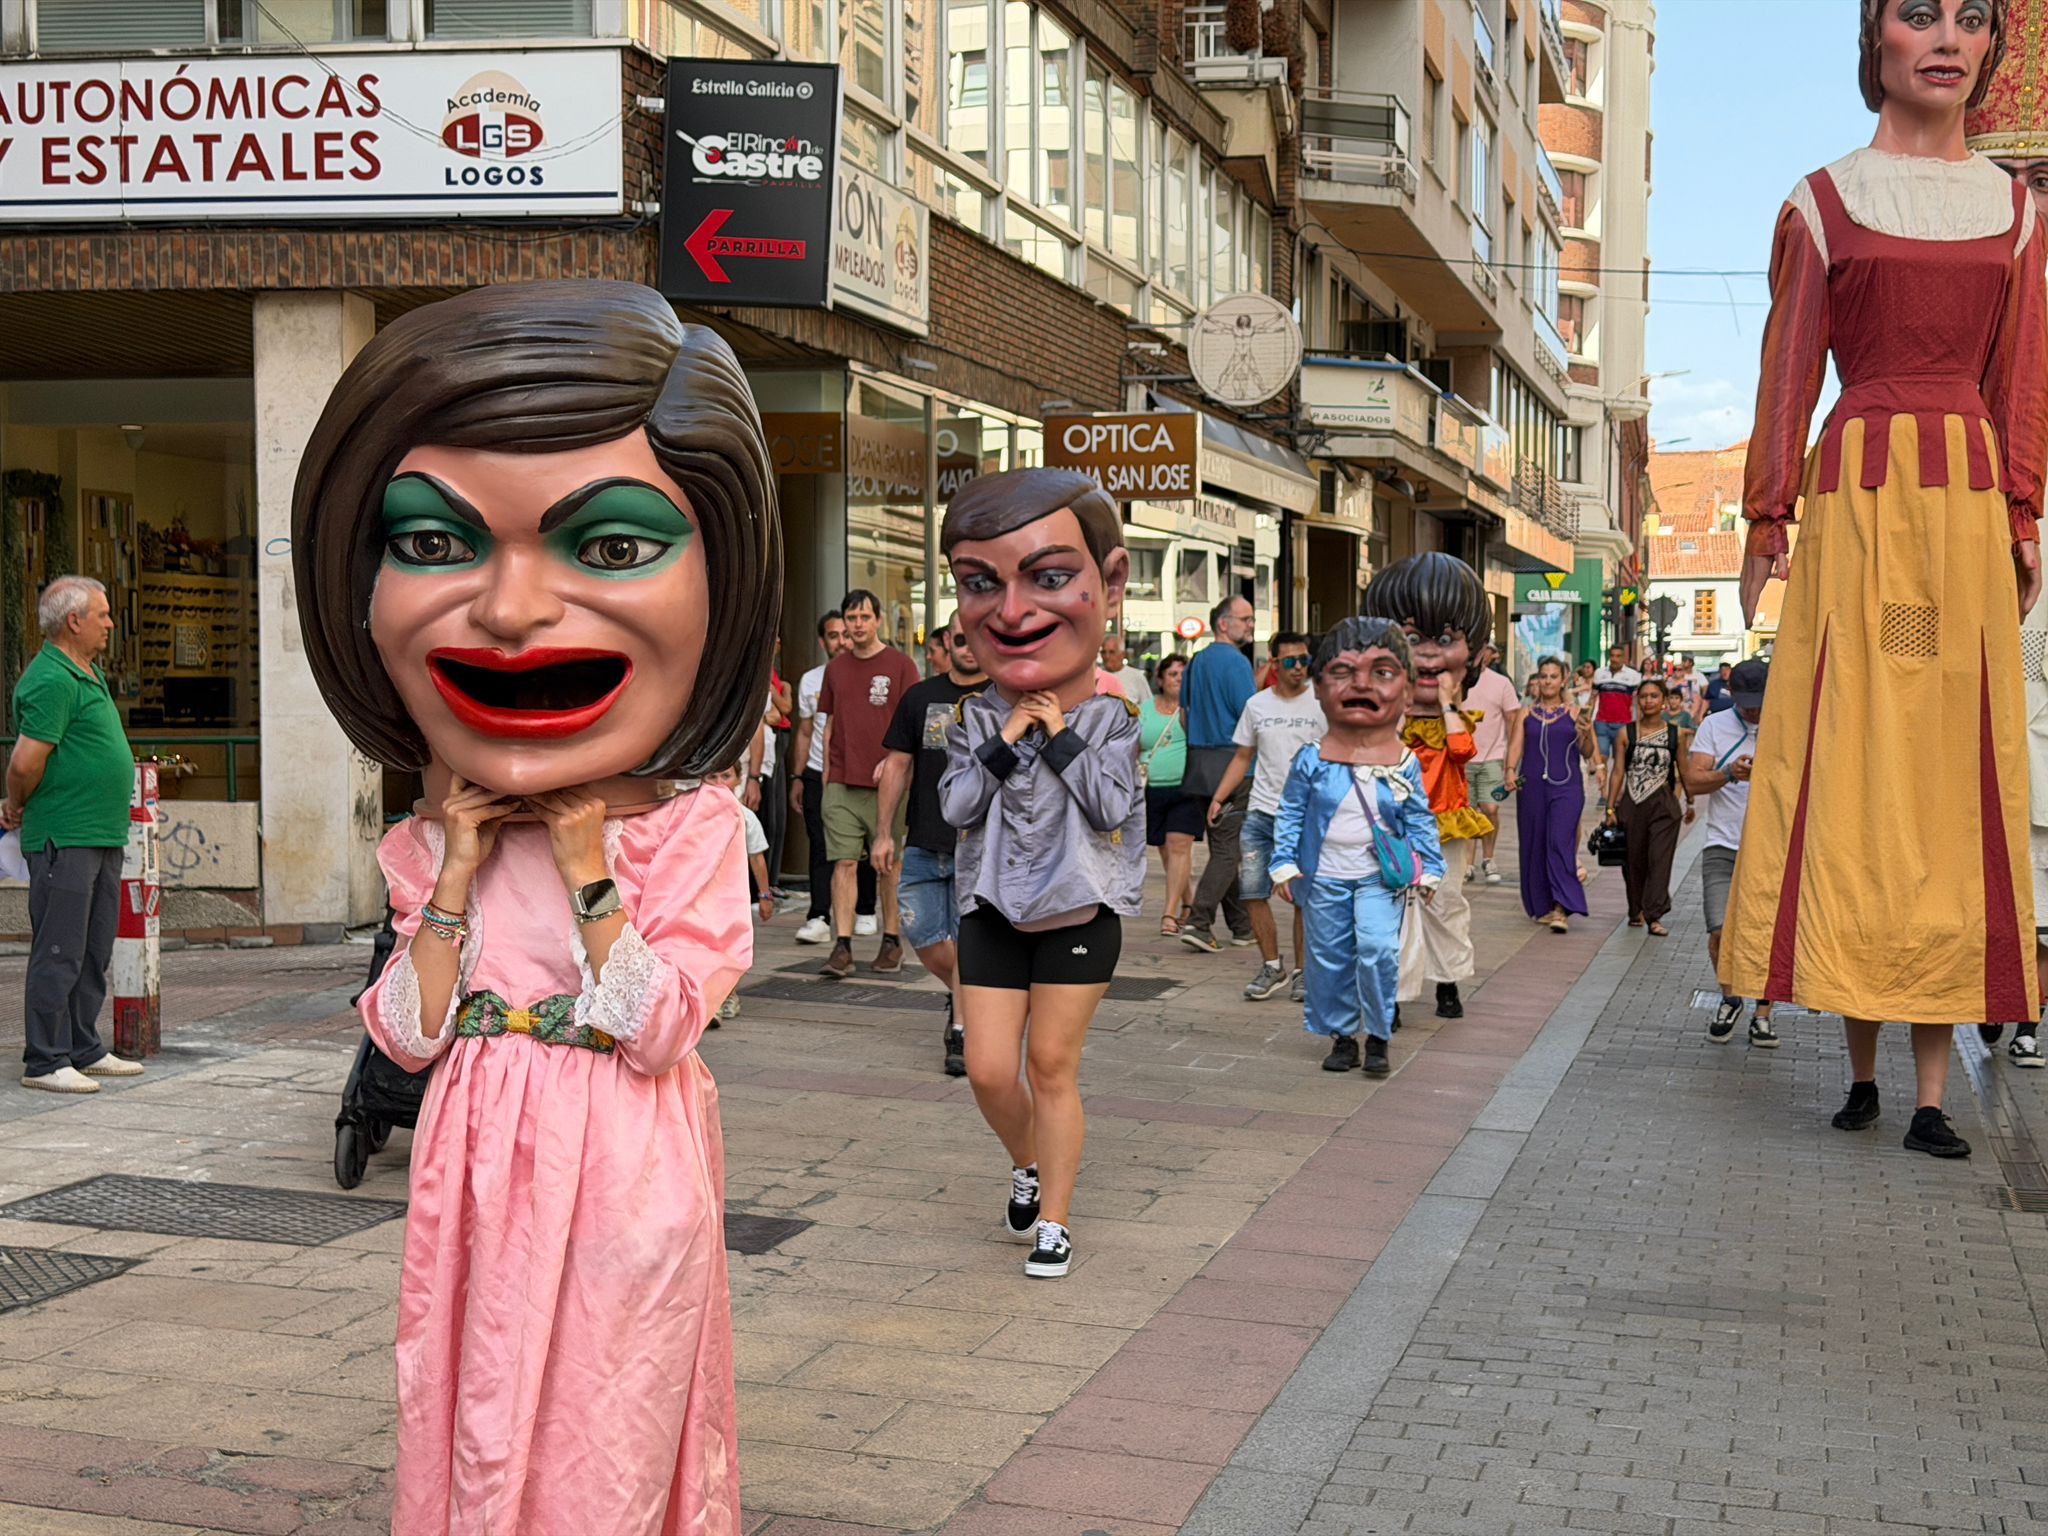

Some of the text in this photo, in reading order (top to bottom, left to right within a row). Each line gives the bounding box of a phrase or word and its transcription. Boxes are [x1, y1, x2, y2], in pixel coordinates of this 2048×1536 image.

[691, 78, 795, 98] Estrella Galicia
[446, 88, 541, 114] Academia
[456, 124, 532, 149] LGS
[727, 132, 743, 151] El
[42, 130, 382, 185] ESTATALES
[692, 135, 823, 181] Castre
[445, 165, 544, 186] LOGOS
[707, 239, 801, 257] PARRILLA
[1322, 412, 1392, 425] ASOCIADOS
[1062, 423, 1175, 454] OPTICA
[1108, 464, 1146, 491] SAN
[1147, 463, 1191, 491] JOSE
[1072, 945, 1088, 955] alo
